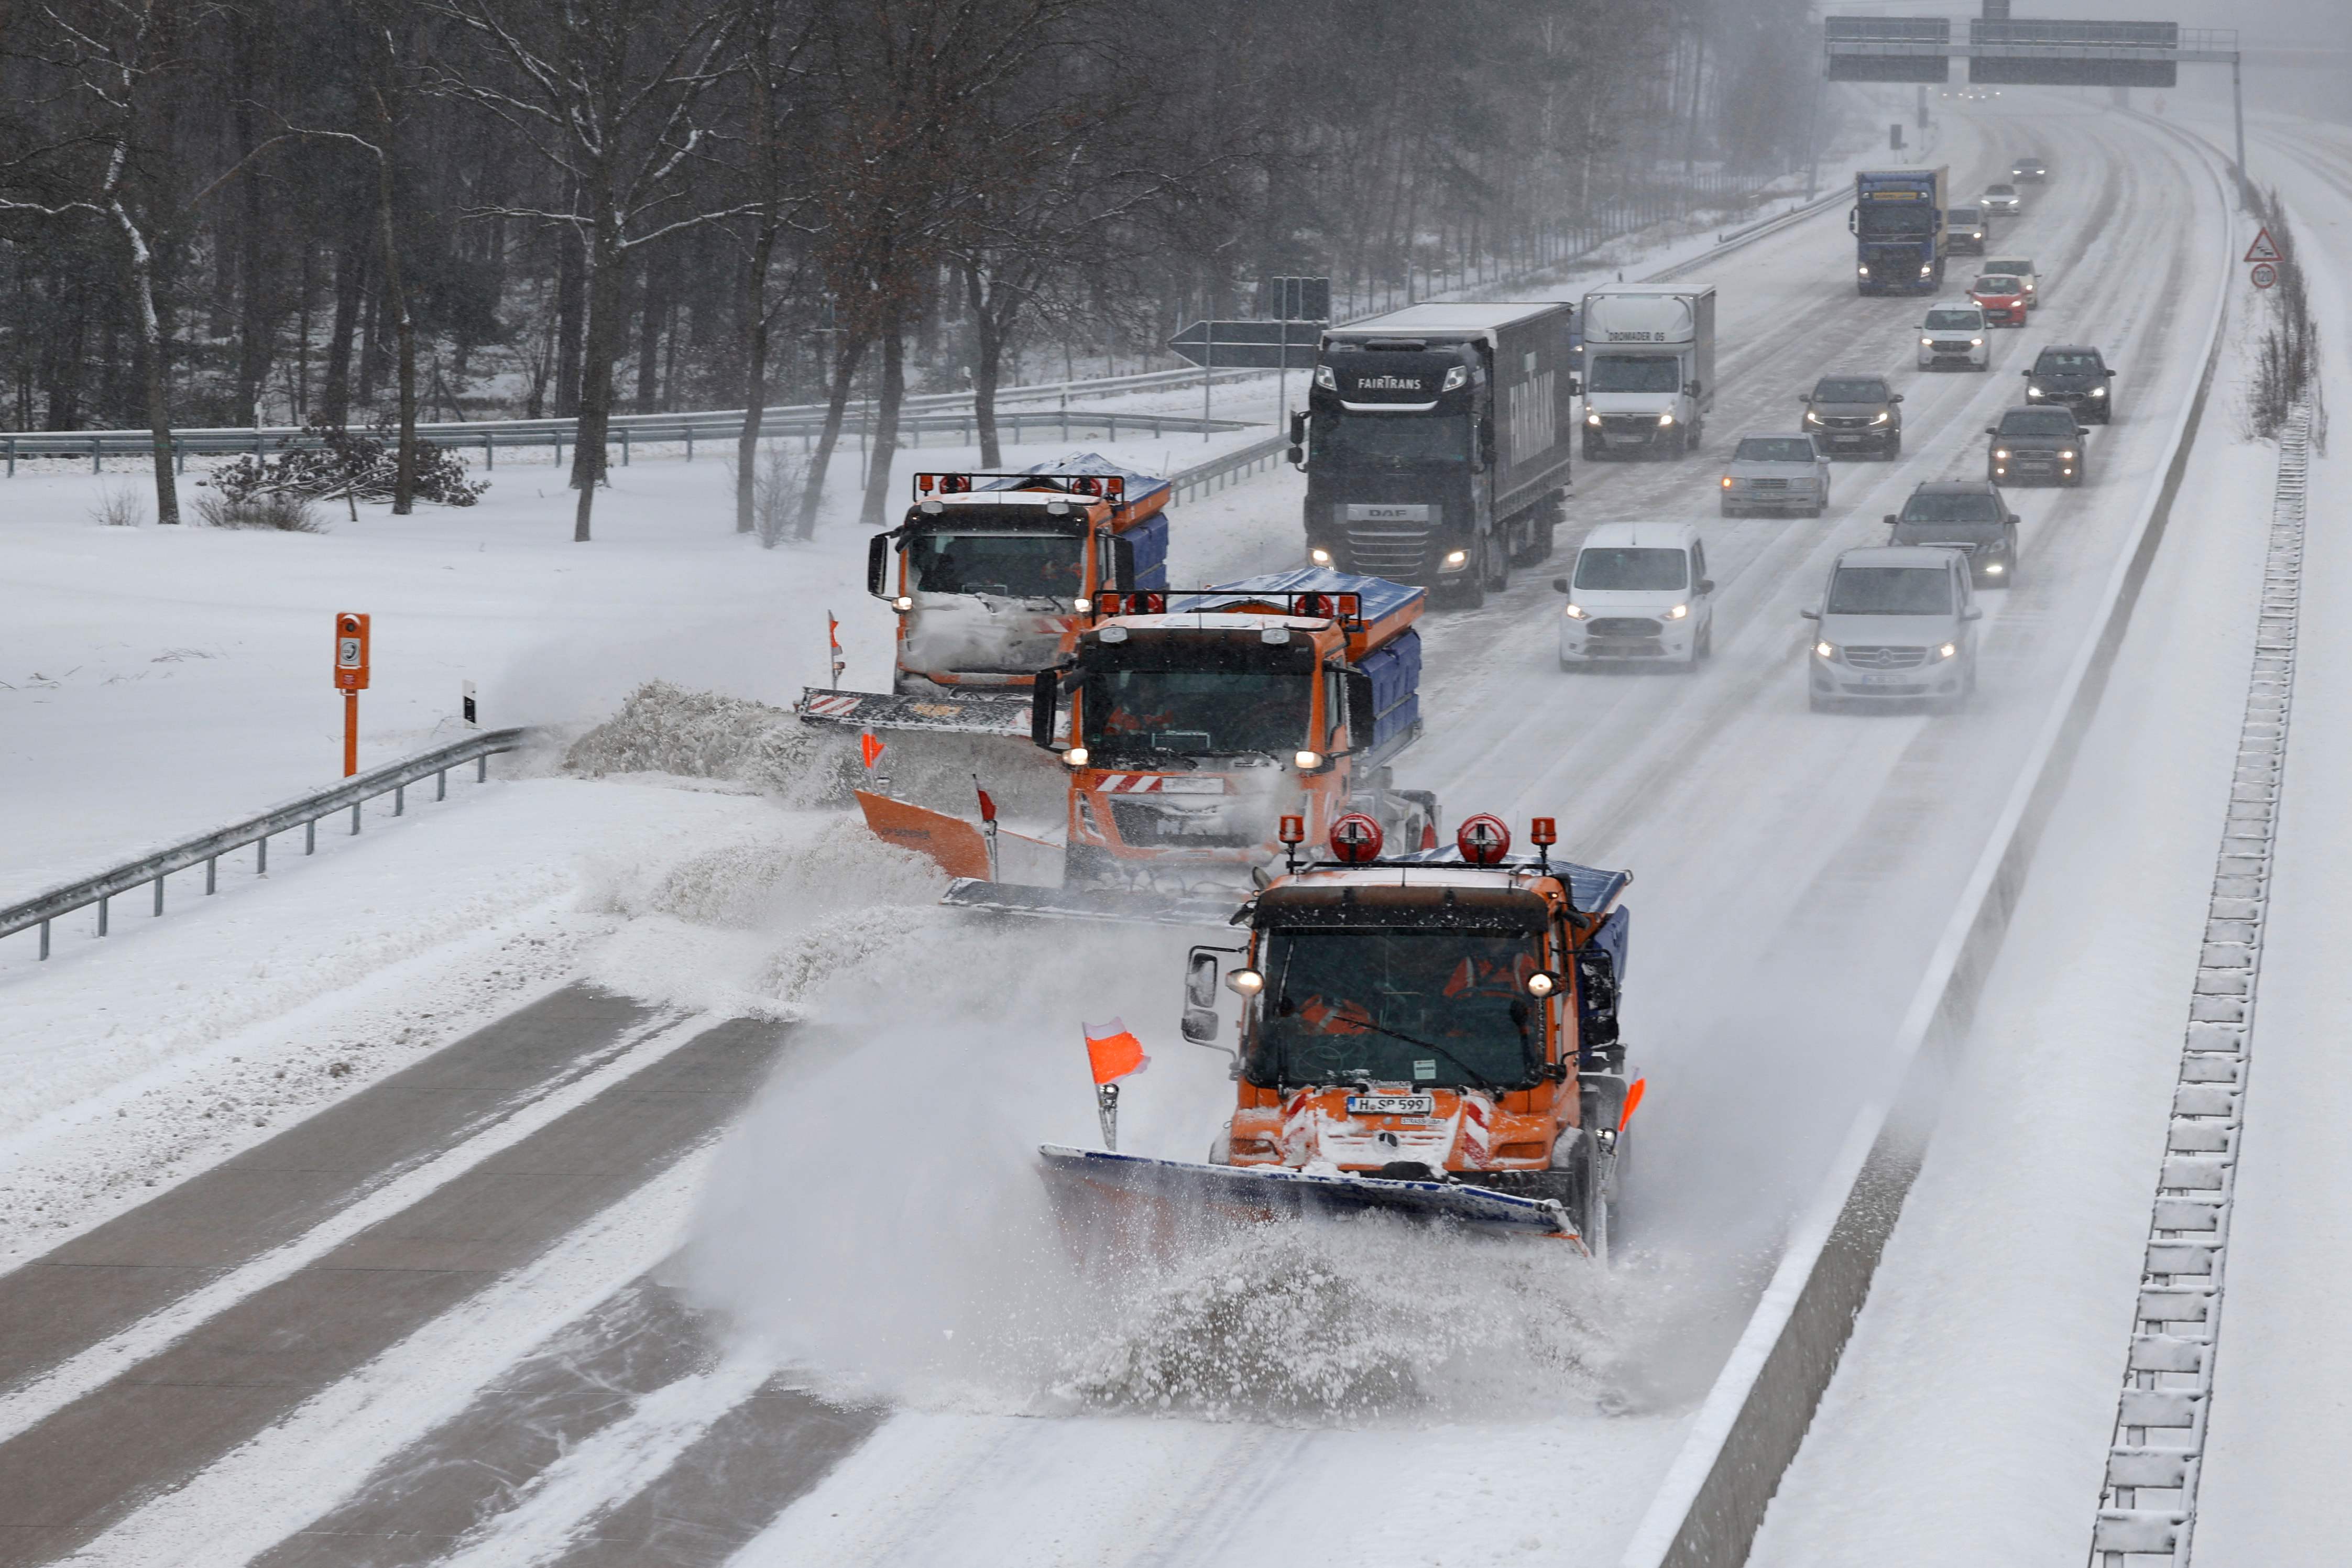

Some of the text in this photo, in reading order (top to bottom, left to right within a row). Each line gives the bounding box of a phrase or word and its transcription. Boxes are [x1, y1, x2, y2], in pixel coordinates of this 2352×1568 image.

[1358, 375, 1421, 389] FAIRTRANS
[1360, 1100, 1369, 1109] H
[1398, 1100, 1424, 1110] 599
